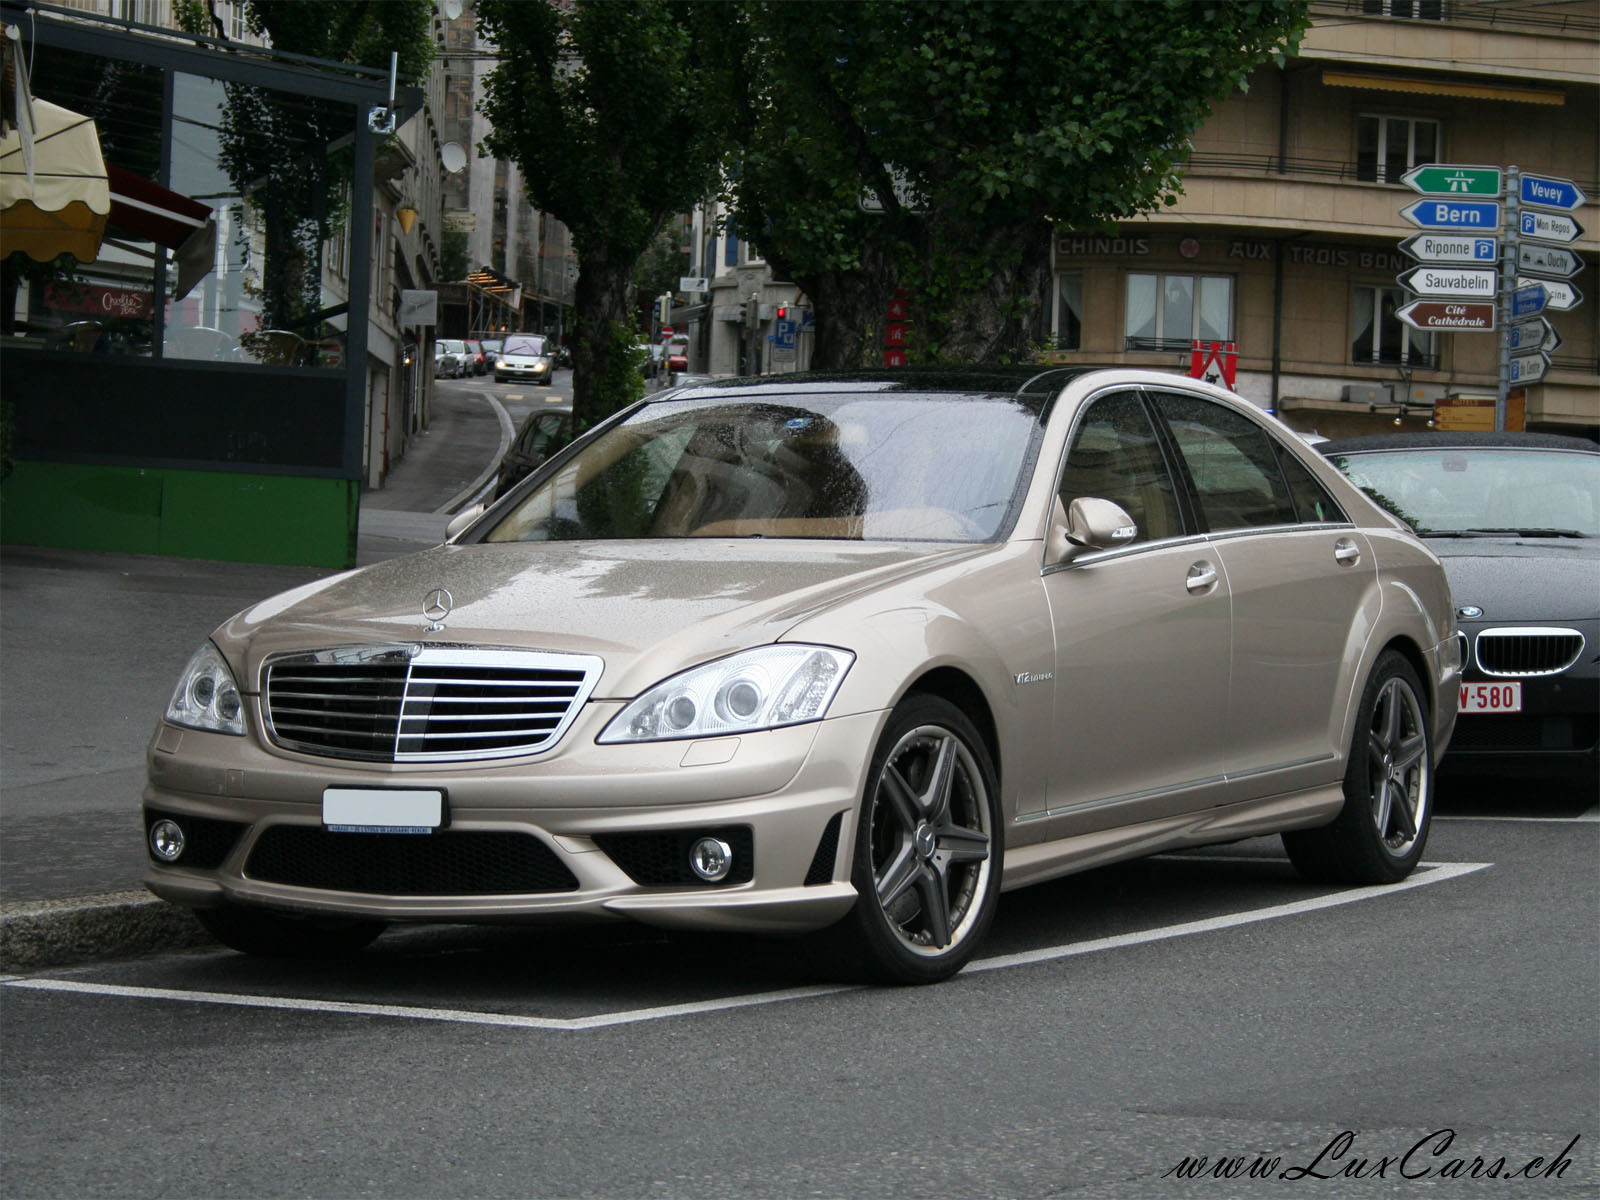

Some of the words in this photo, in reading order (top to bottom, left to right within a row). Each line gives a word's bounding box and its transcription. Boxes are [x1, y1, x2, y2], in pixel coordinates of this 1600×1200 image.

[1531, 181, 1563, 203] Vevey
[1436, 204, 1480, 224] Bern
[1536, 219, 1549, 231] Mon
[1551, 220, 1570, 235] Repos
[1057, 238, 1149, 254] CHINOIS
[1230, 242, 1271, 259] AUX
[1291, 247, 1350, 266] TROIS
[1425, 240, 1470, 257] Riponne
[1547, 252, 1569, 272] Ouchy
[1425, 274, 1489, 290] Sauvabelin
[1445, 305, 1467, 315] Cité
[1428, 315, 1486, 327] Cathédrale
